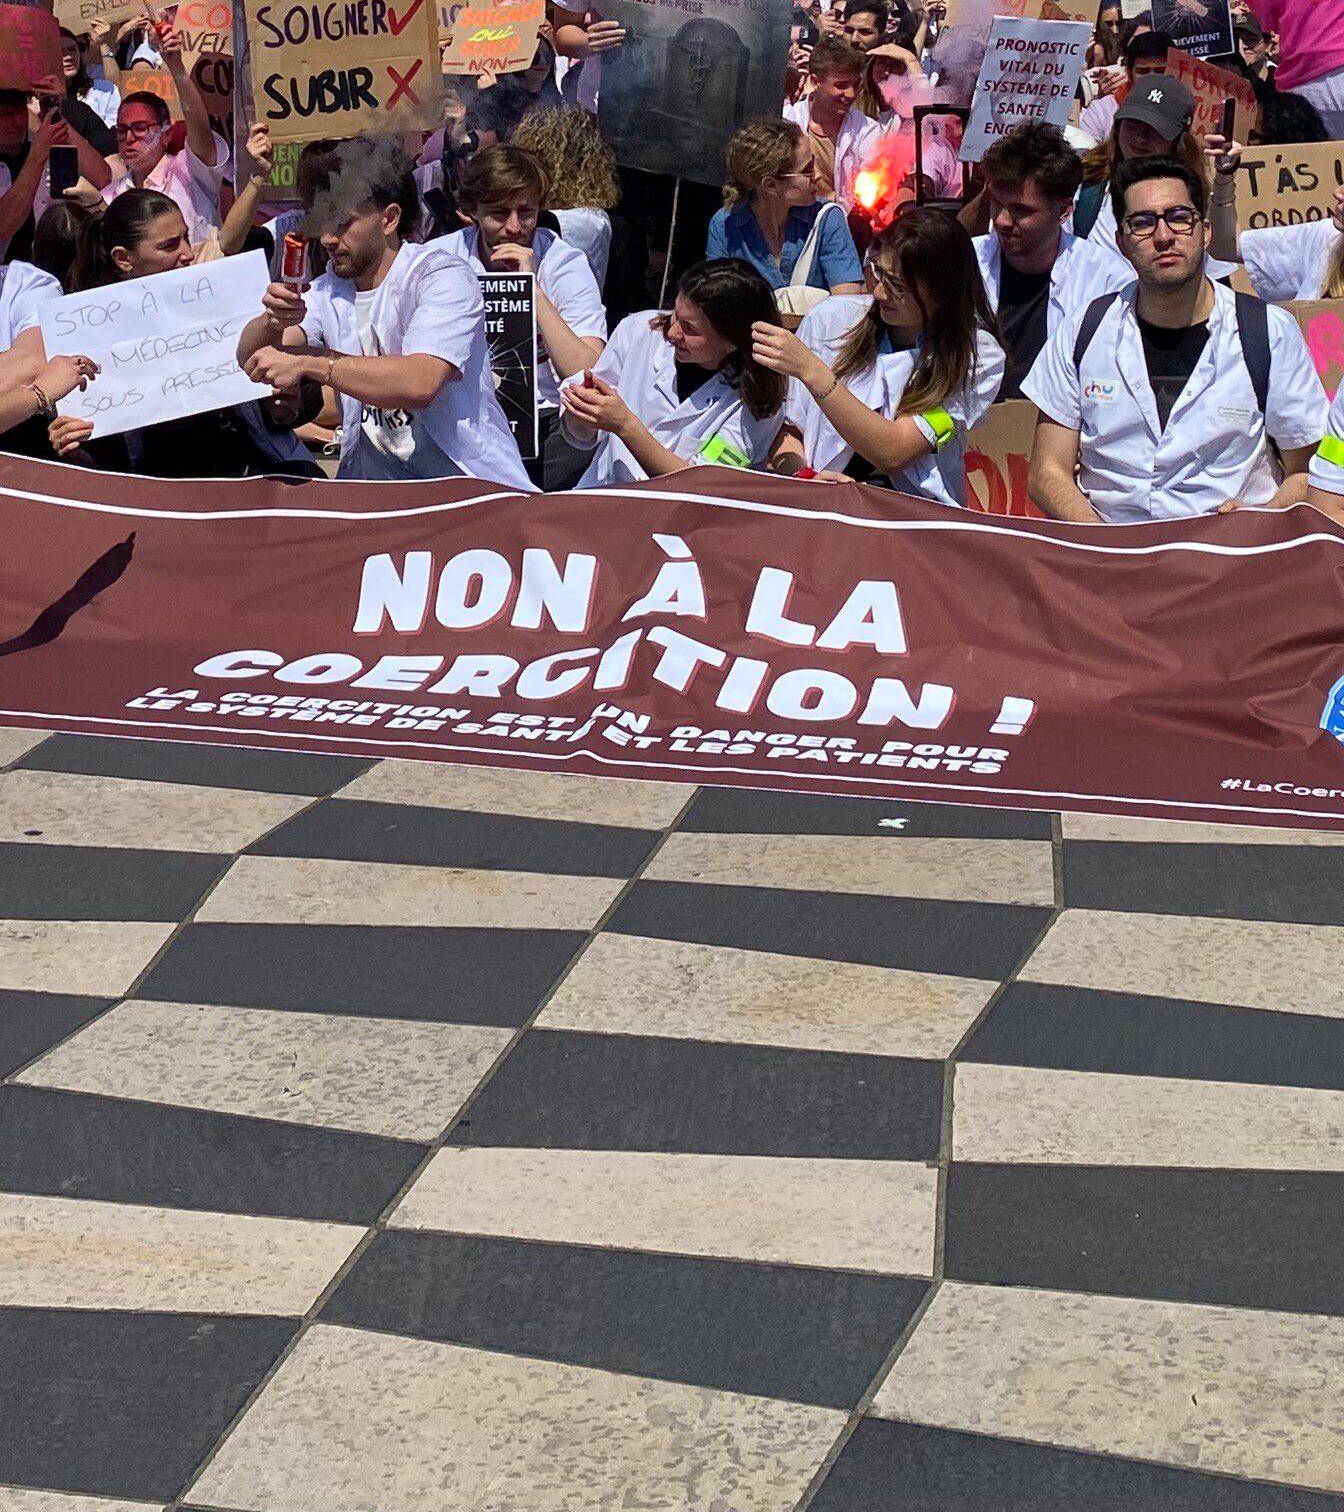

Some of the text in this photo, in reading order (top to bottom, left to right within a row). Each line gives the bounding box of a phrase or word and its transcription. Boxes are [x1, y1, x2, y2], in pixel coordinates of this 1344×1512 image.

[995, 37, 1081, 56] PRONOSTIC
[999, 59, 1066, 76] VITAL DU
[262, 66, 380, 120] SUBIR
[982, 79, 1070, 98] SYSTEME DE
[55, 276, 215, 338] STOP À LA
[81, 388, 144, 419] SOUS
[352, 532, 910, 656] NON À LA
[193, 624, 956, 732] COERCITION
[125, 696, 183, 712] LE
[185, 701, 382, 727] SYSTÈME
[384, 715, 447, 732] DE
[601, 727, 663, 749] ET
[670, 734, 758, 756] LES
[766, 746, 1003, 775] PATIENTS
[144, 687, 1011, 763] LA COERCITION EST UN DANGER POUR
